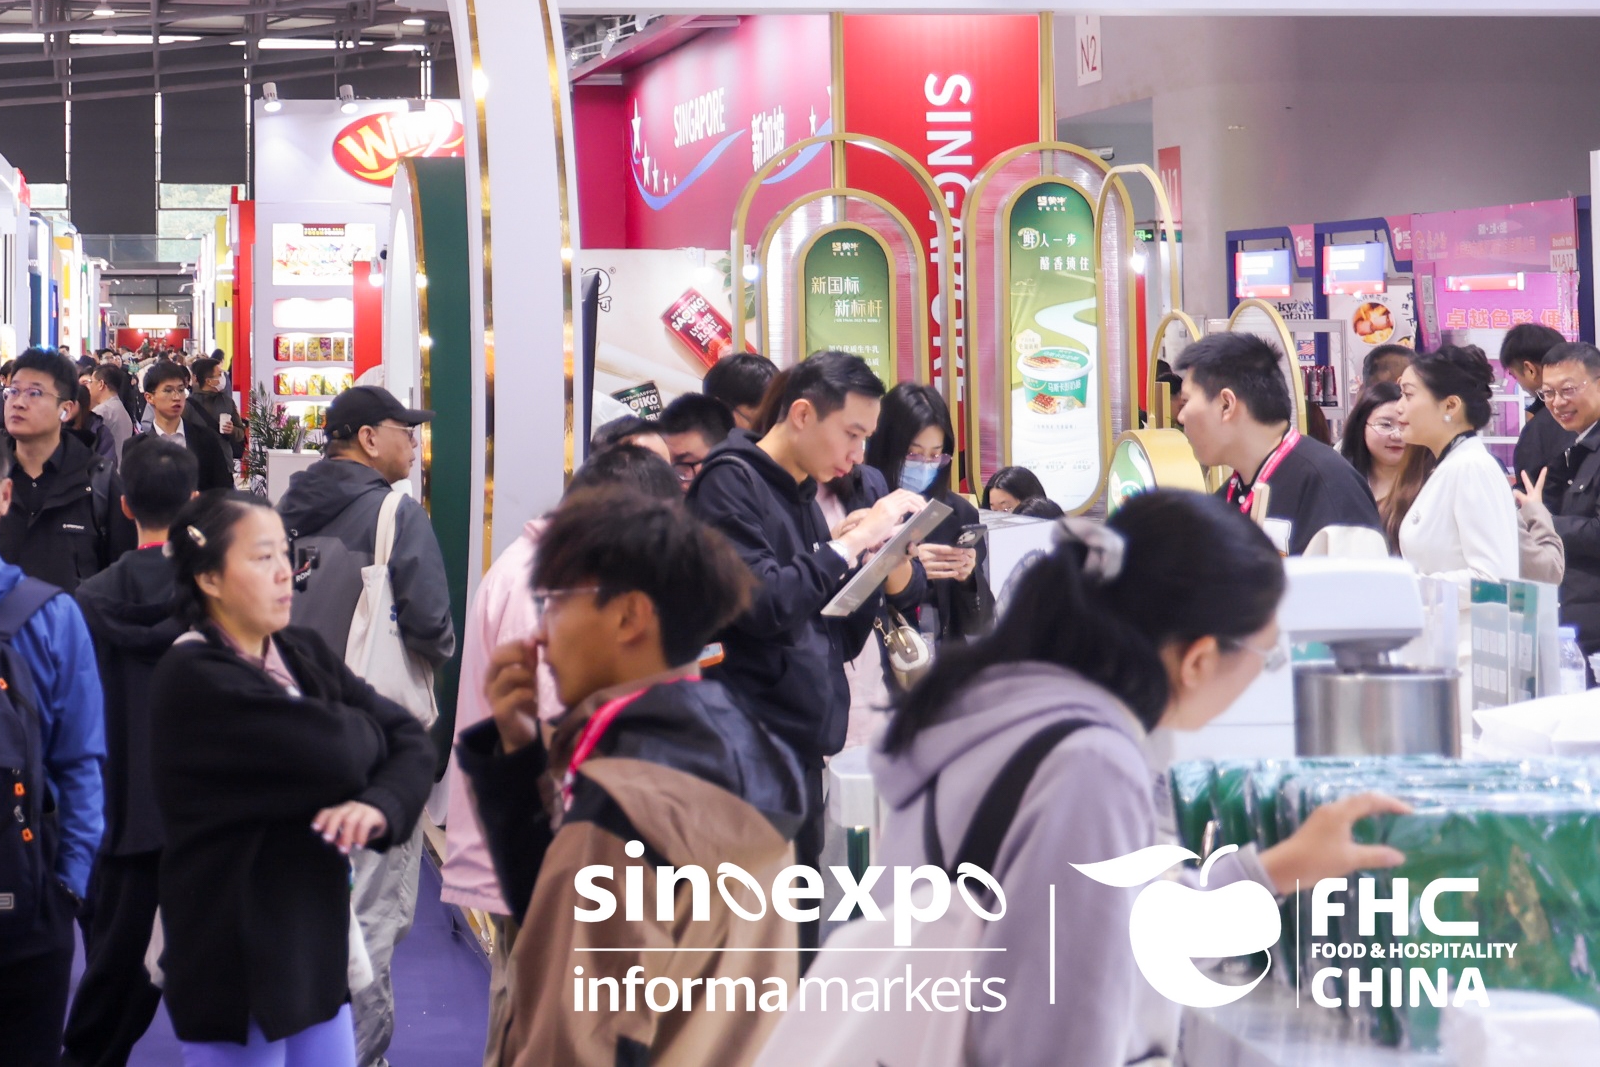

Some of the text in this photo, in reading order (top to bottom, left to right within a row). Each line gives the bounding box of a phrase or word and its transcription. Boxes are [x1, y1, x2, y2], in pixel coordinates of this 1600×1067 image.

[1081, 35, 1097, 74] N2
[673, 87, 726, 148] SINGAPORE
[811, 276, 860, 295] 新国标
[834, 299, 882, 318] 新标杆
[689, 312, 714, 337] LYCHEE
[697, 320, 718, 343] FLOAT
